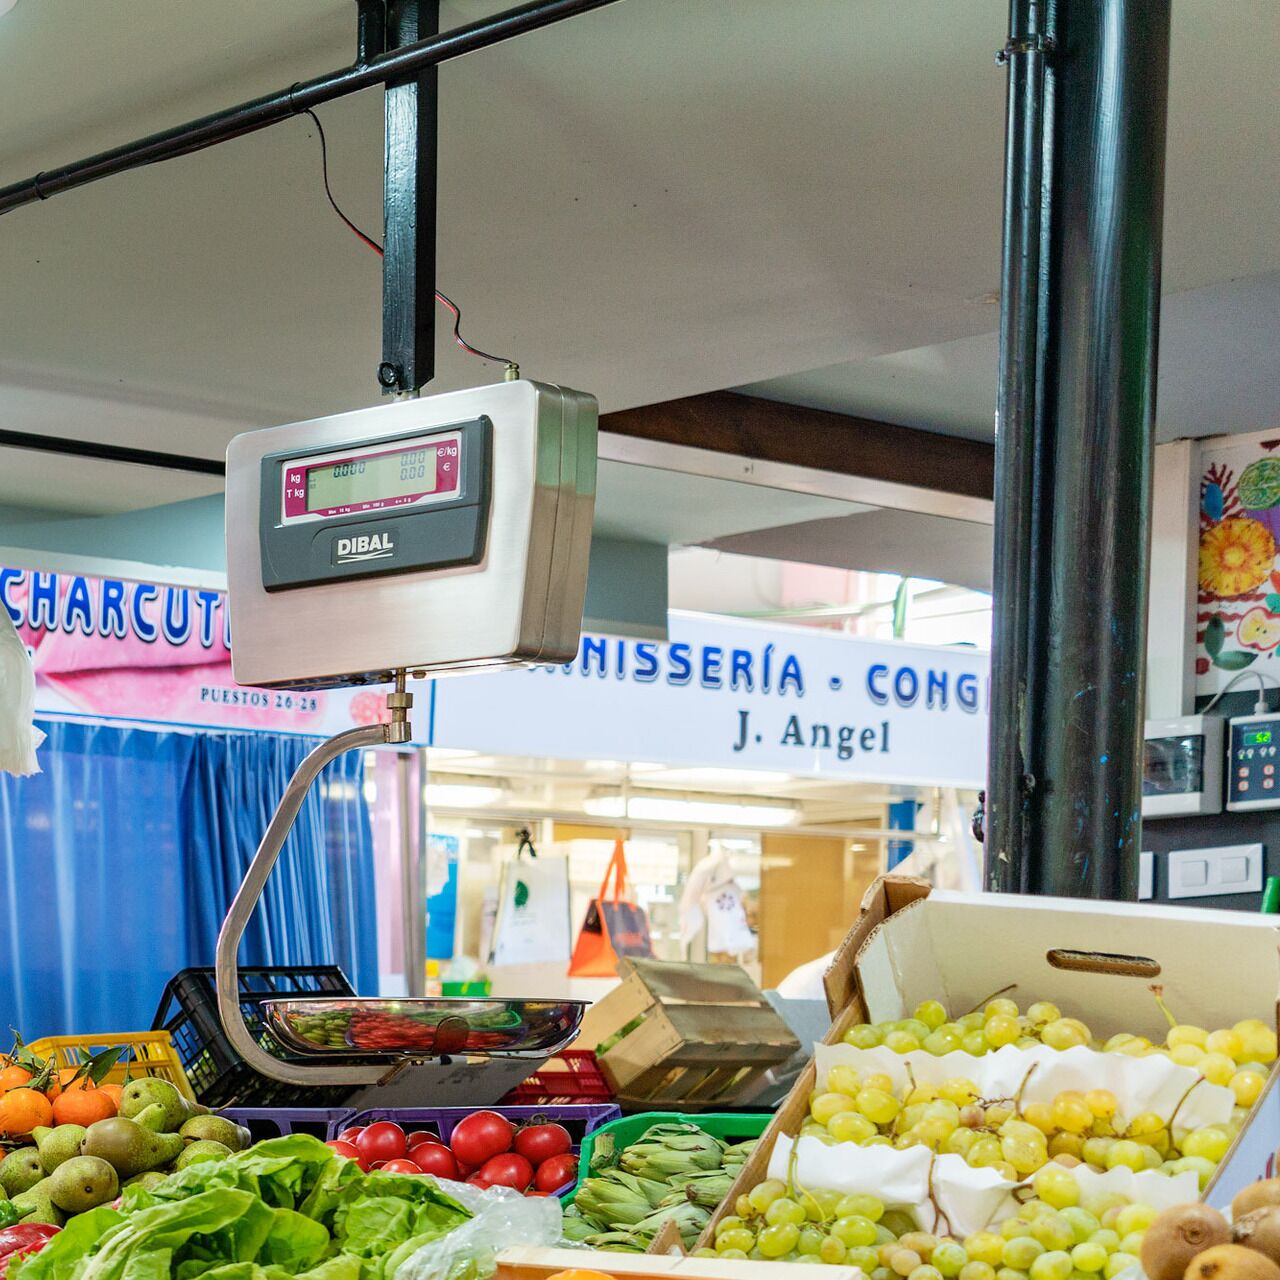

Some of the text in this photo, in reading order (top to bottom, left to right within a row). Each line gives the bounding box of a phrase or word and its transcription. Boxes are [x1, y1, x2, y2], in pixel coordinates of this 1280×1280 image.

[400, 450, 425, 467] 0.00
[437, 445, 458, 458] €/kg
[290, 473, 302, 485] kg
[400, 464, 425, 481] 0.00
[286, 486, 305, 499] T kg
[337, 532, 394, 556] DIBAL
[528, 637, 989, 713] NISSERÍA CONG
[200, 687, 319, 712] PUESTOS 26-28
[732, 710, 891, 760] J. Angel
